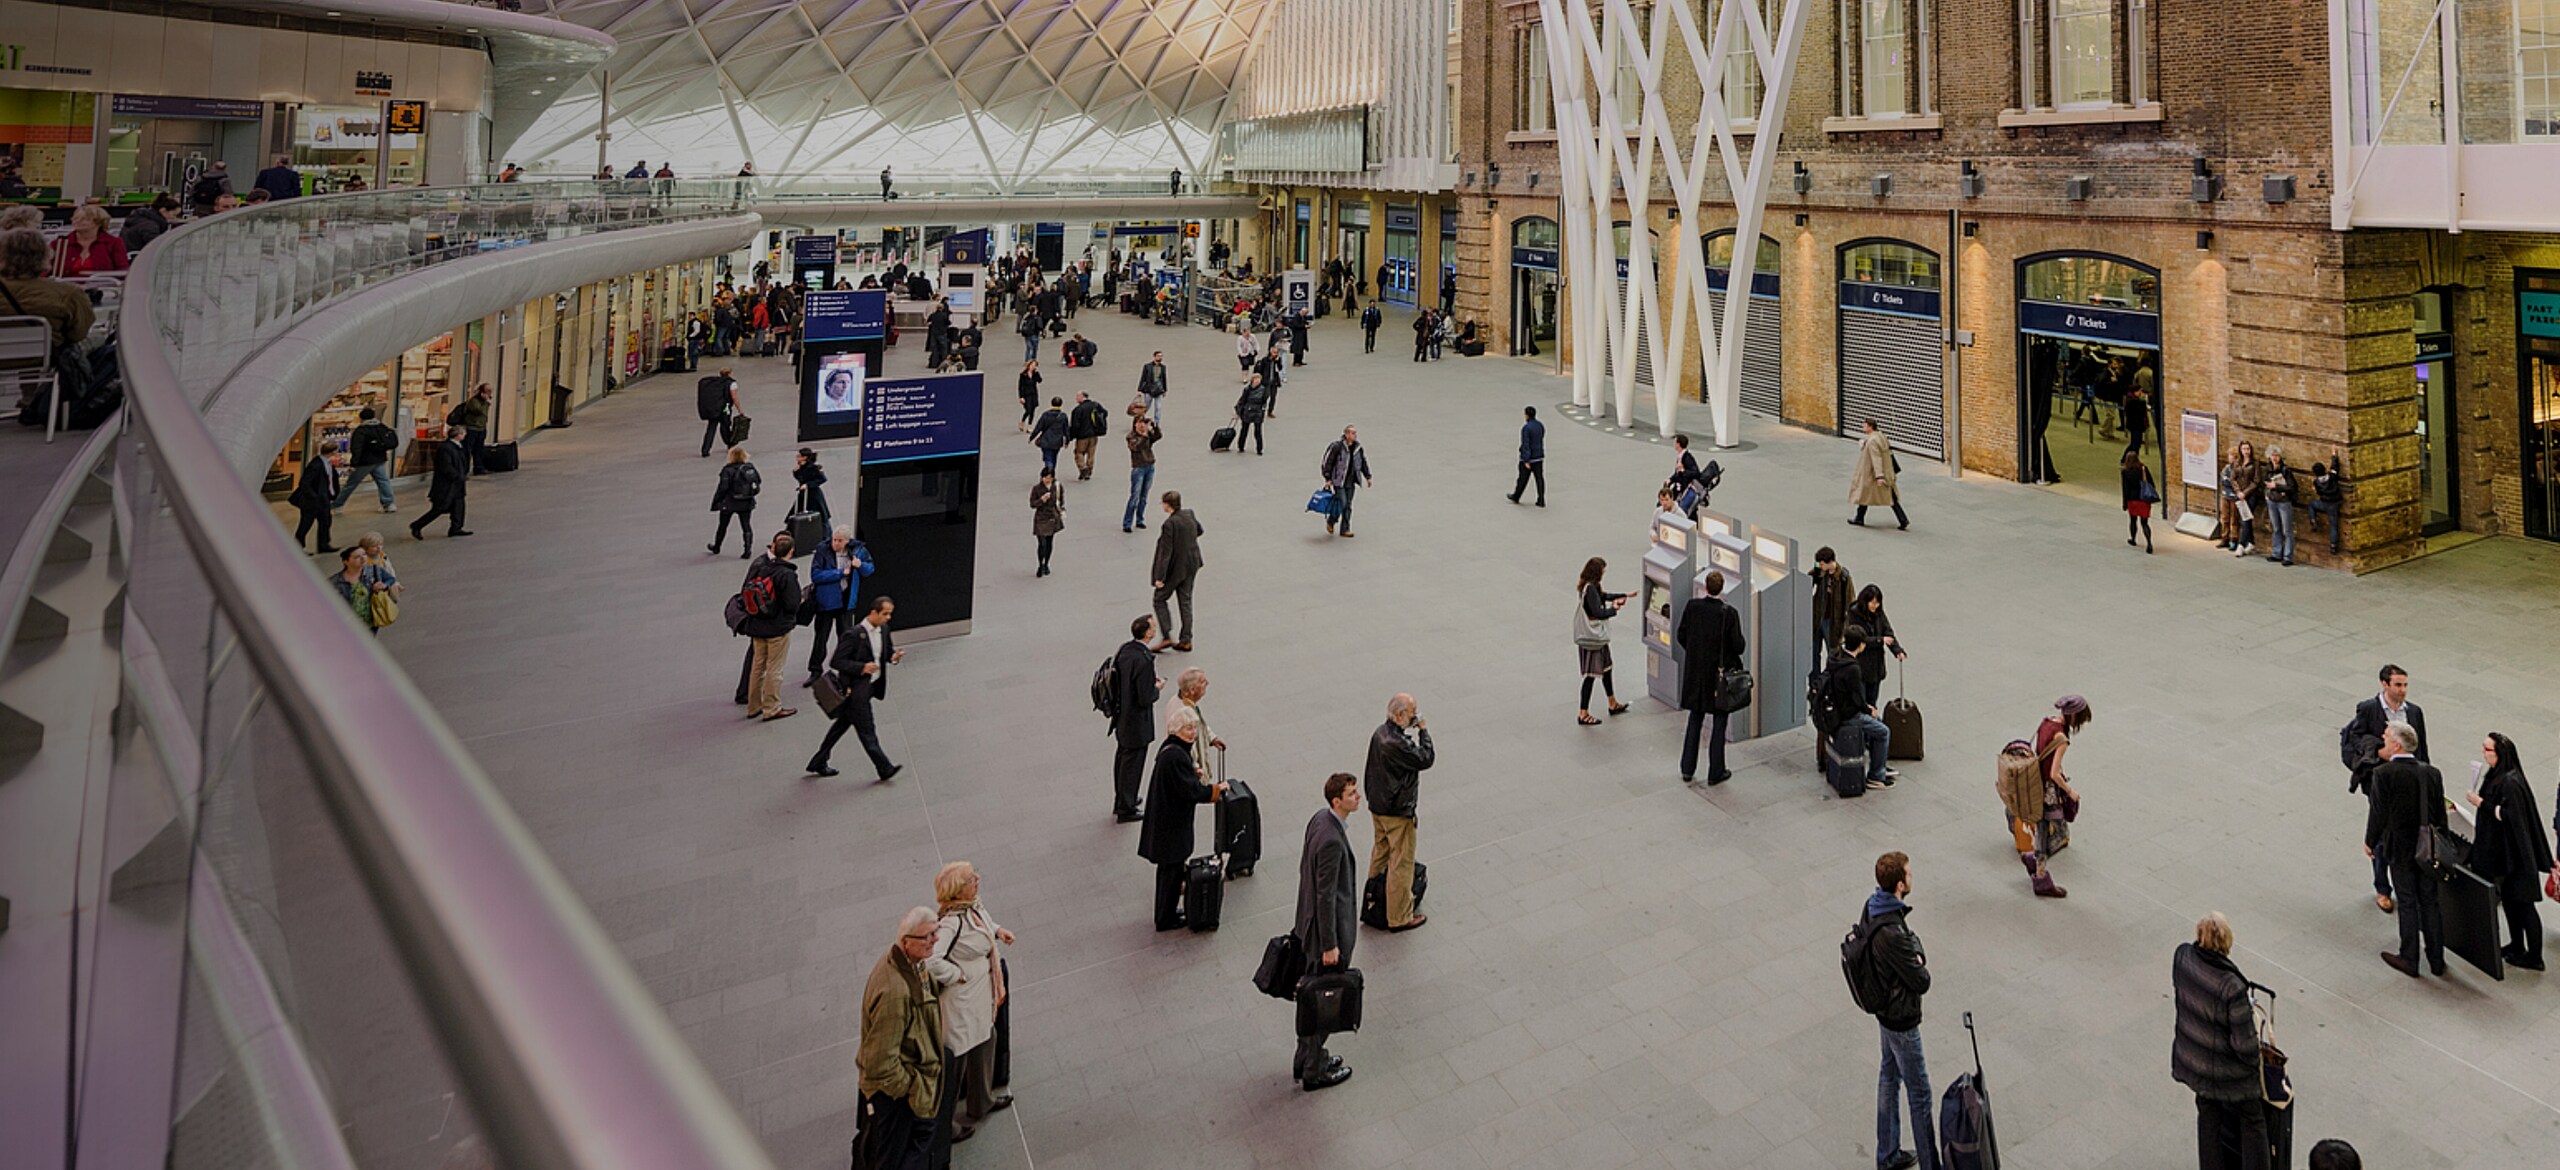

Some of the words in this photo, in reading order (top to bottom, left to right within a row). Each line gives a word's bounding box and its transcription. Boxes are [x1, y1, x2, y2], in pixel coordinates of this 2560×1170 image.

[2077, 316, 2107, 329] Tickets
[887, 385, 925, 394] Underground
[883, 439, 912, 448] Platforms
